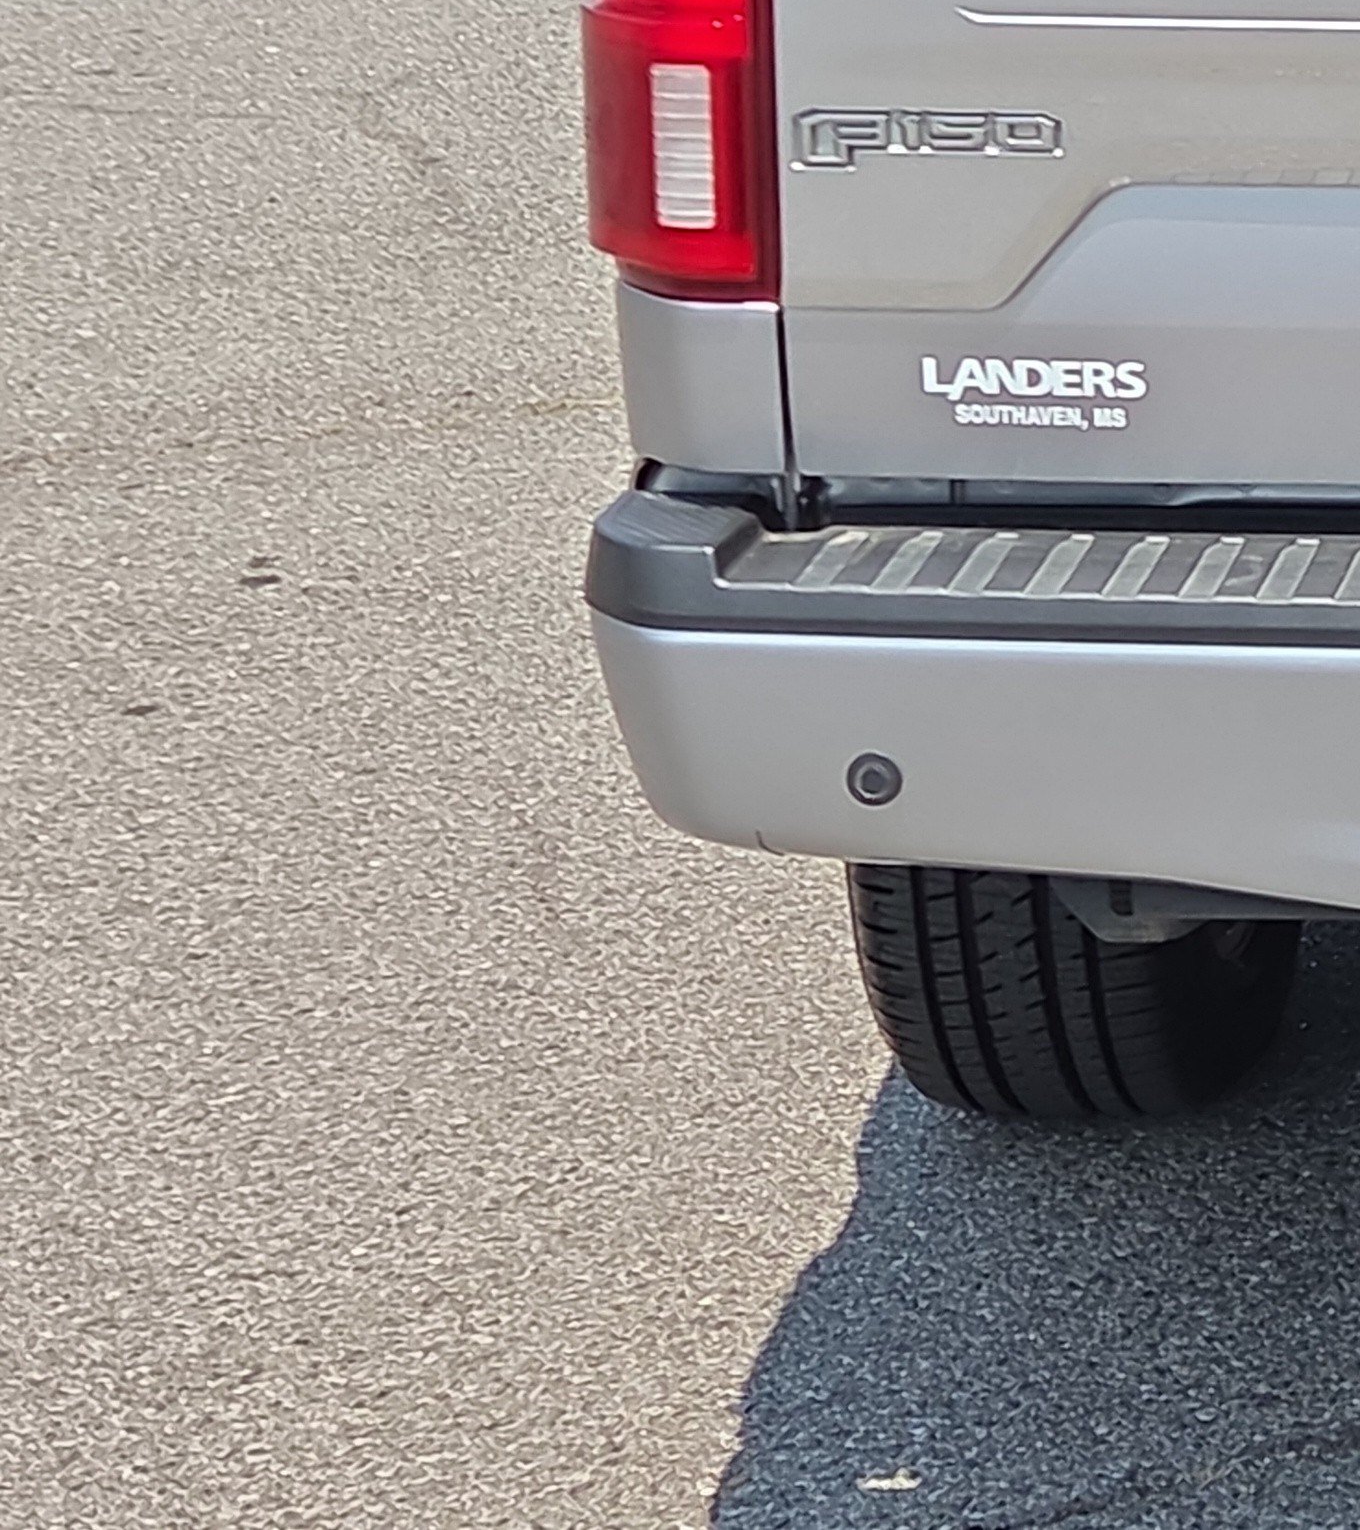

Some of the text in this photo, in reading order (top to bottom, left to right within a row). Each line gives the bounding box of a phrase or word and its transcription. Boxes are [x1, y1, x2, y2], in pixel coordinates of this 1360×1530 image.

[920, 356, 1149, 402] LANDERS
[953, 403, 1128, 431] SOUTHAVEN, MS
